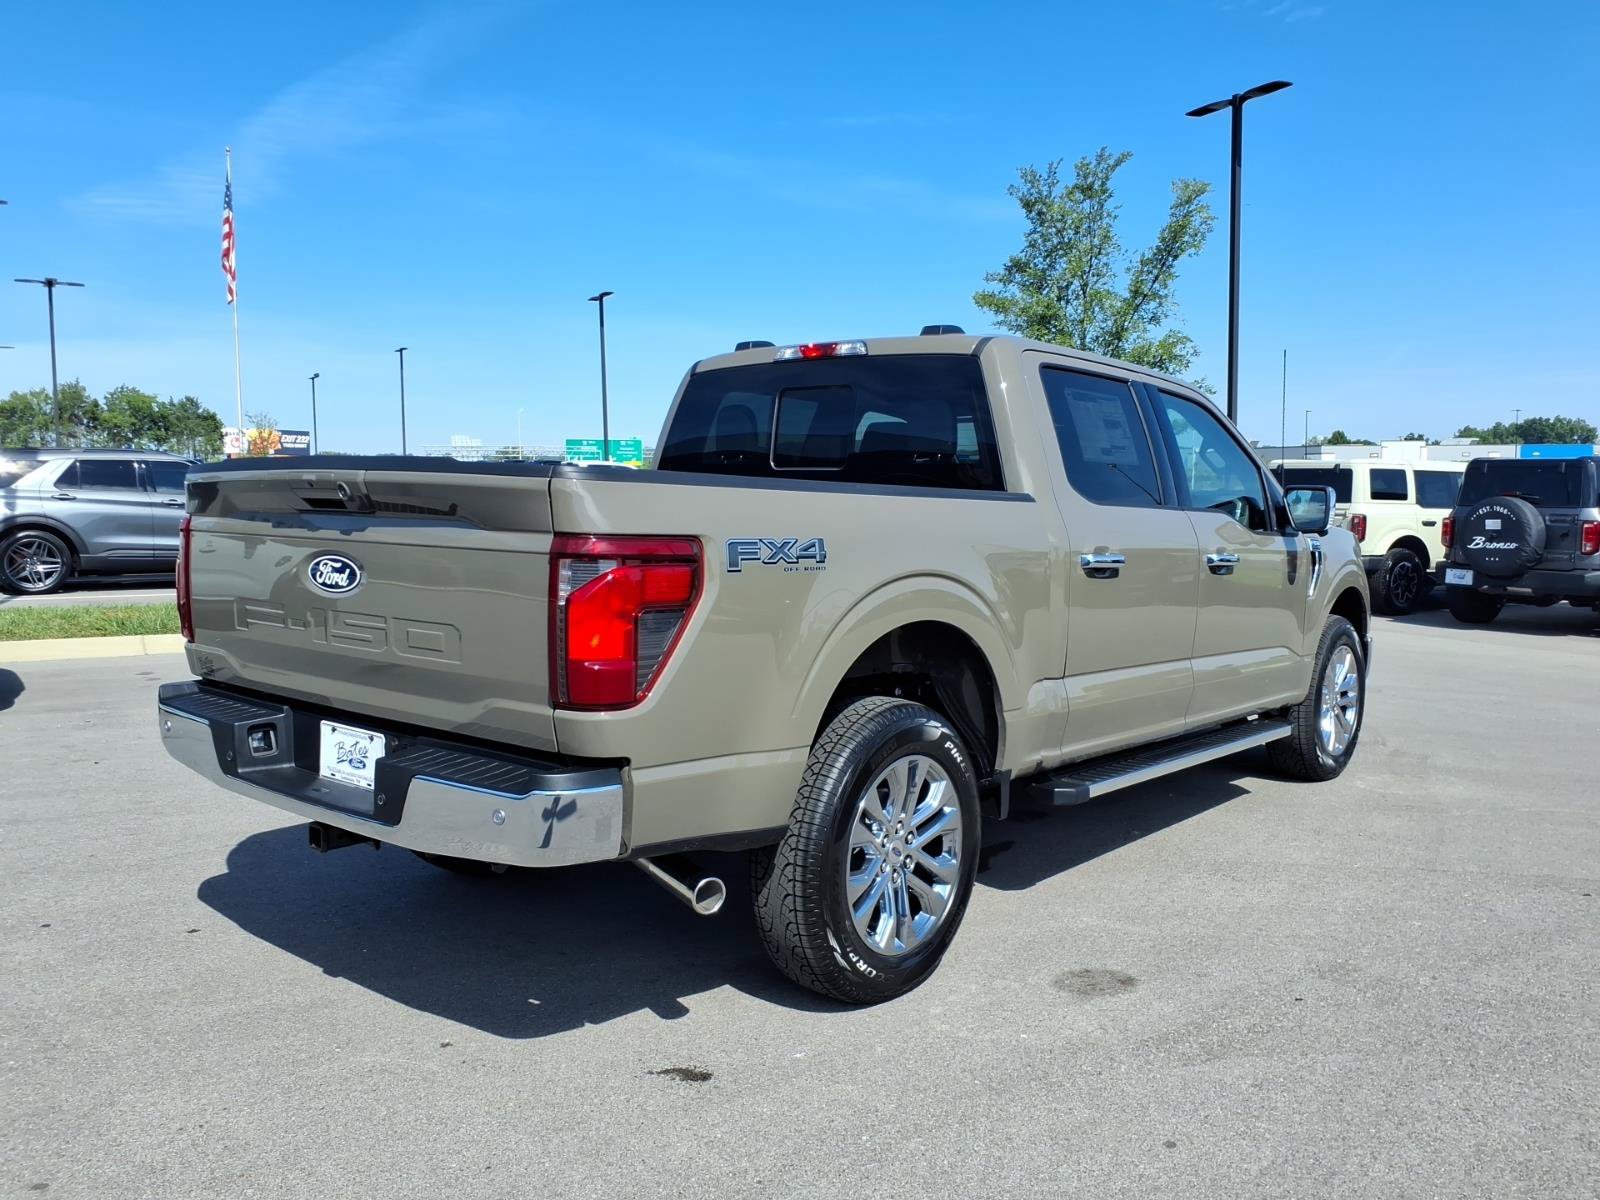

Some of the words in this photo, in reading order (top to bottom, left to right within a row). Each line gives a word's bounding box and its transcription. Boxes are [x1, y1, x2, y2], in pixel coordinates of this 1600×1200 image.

[281, 434, 297, 443] EXIT
[1467, 536, 1519, 549] Bronco
[725, 538, 826, 572] FX4
[314, 558, 351, 588] Ford
[334, 740, 369, 760] Bates
